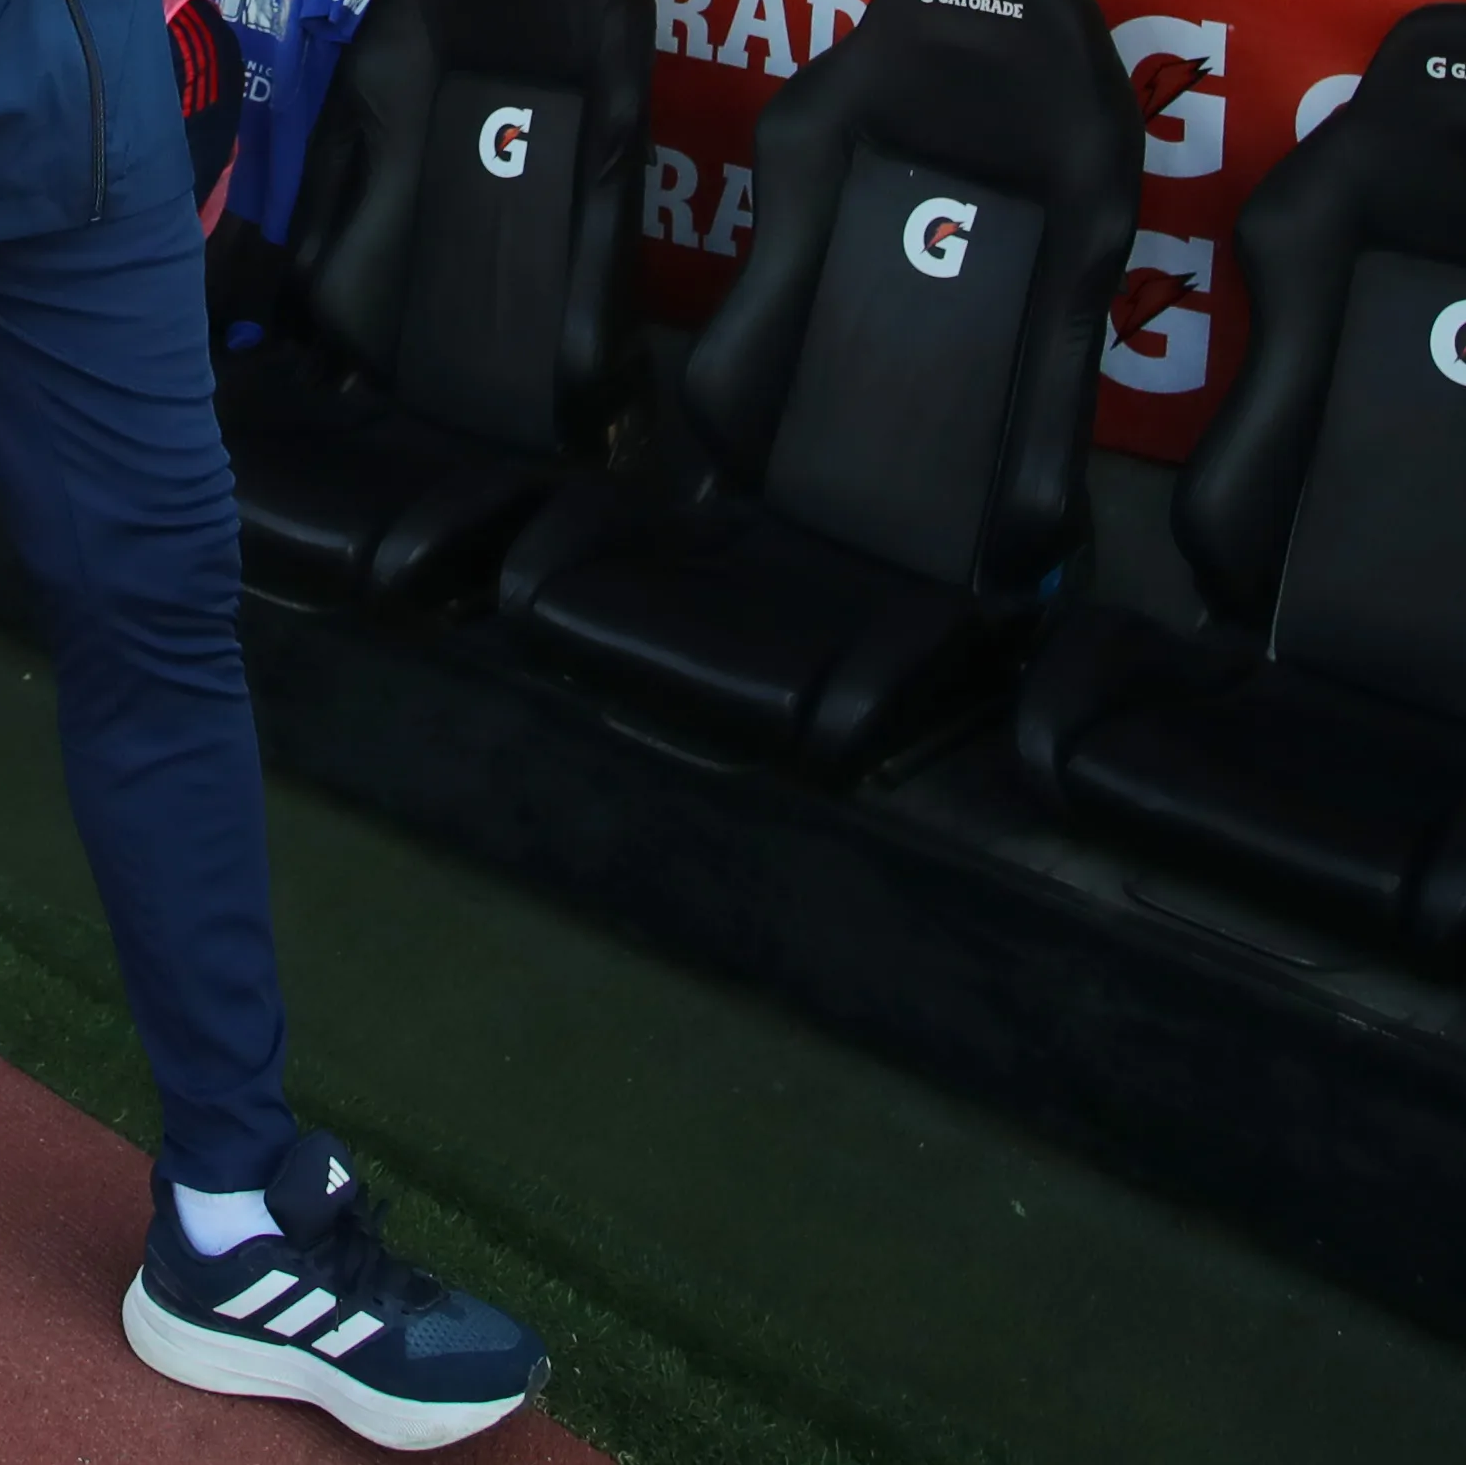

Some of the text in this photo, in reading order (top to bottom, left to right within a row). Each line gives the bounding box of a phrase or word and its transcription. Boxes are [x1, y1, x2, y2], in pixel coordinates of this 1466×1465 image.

[1426, 57, 1446, 79] G
[479, 107, 533, 178] G
[903, 197, 978, 278] G
